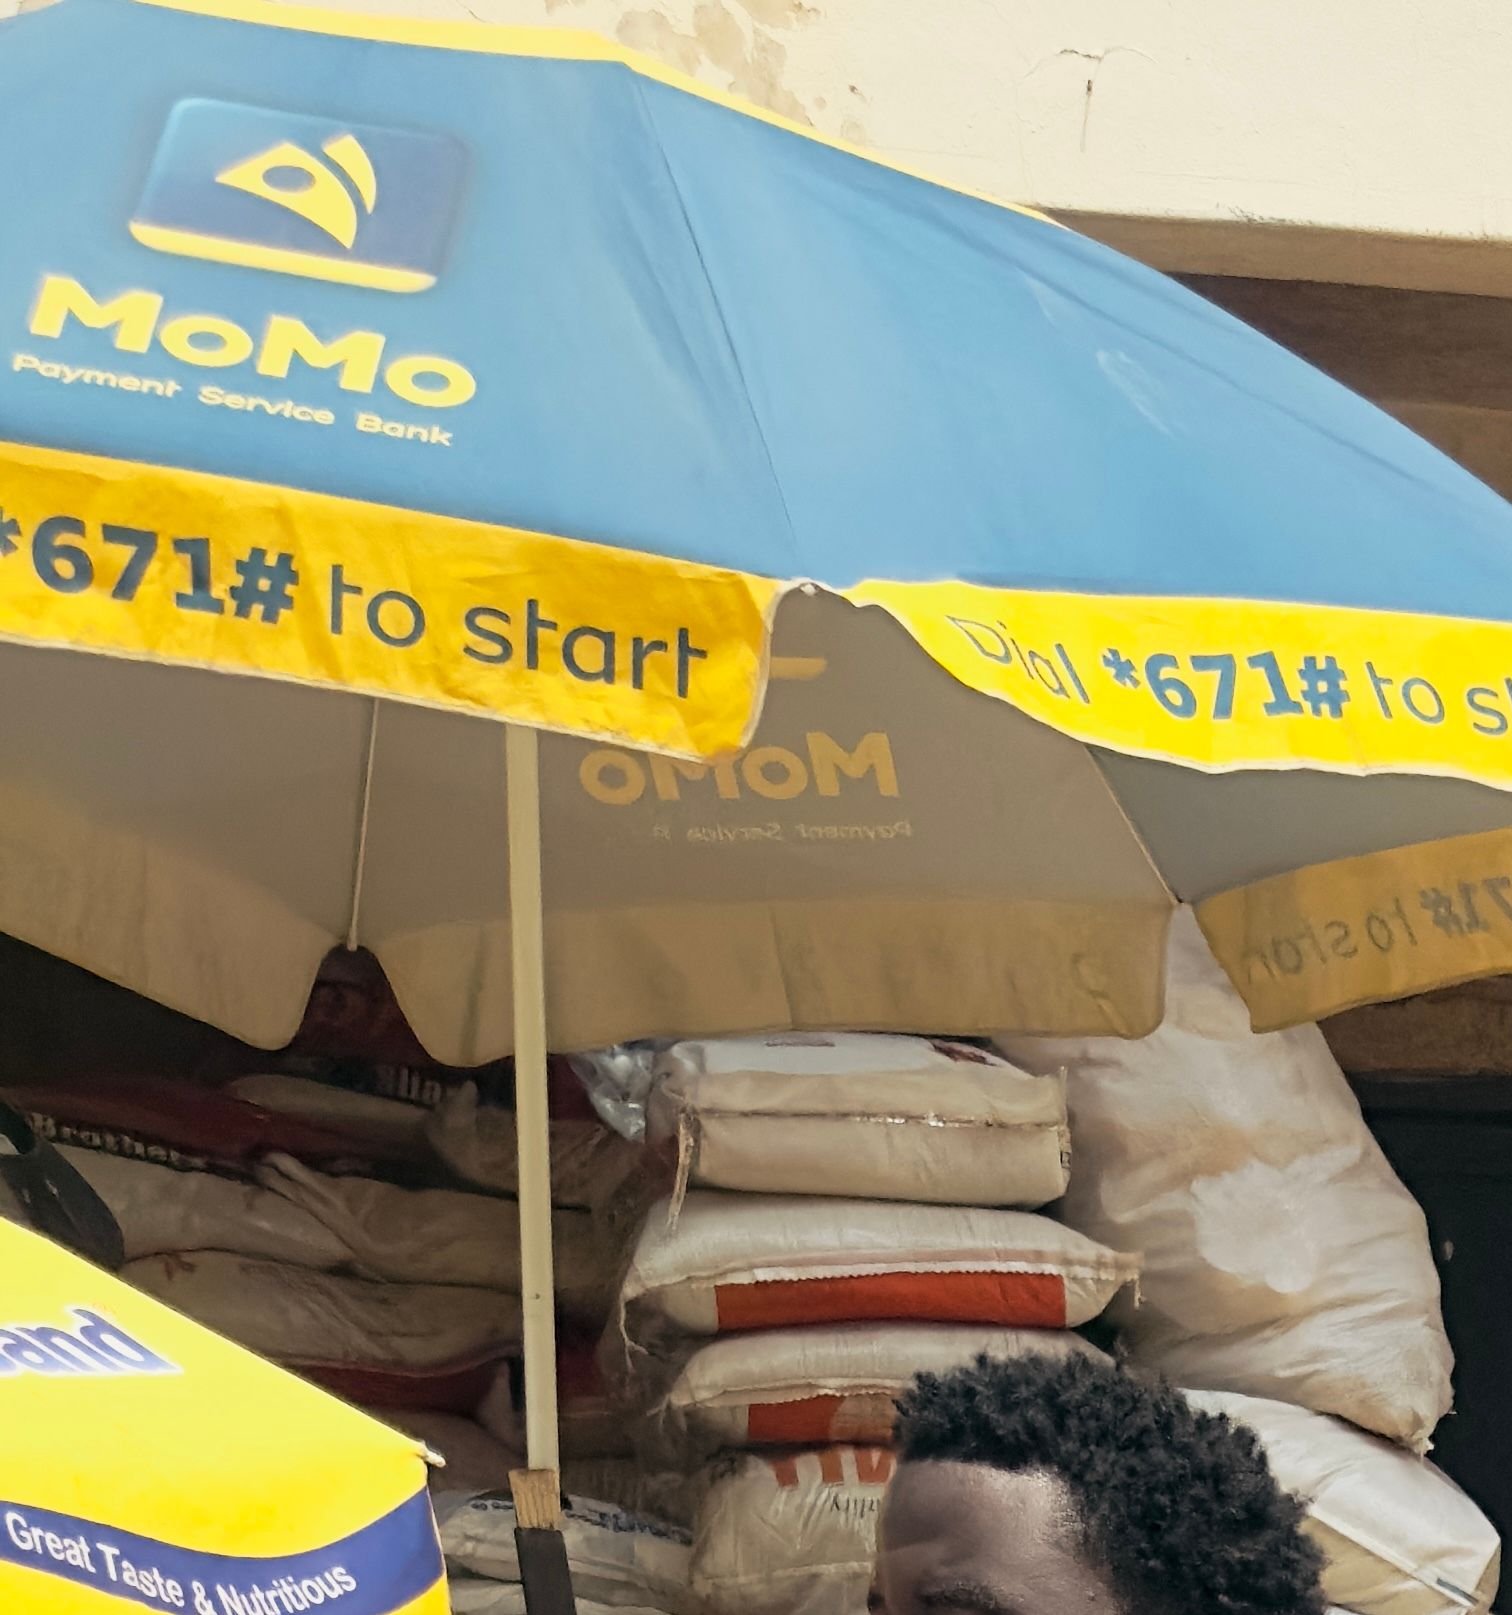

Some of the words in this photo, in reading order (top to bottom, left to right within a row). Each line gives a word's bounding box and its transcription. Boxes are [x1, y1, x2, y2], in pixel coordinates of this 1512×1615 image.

[29, 273, 477, 408] MoMo
[13, 353, 182, 399] Payment
[198, 384, 335, 426] Service
[356, 413, 453, 447] Bank
[330, 563, 426, 648] to
[463, 598, 707, 698] start
[946, 614, 1090, 705] Dial
[1366, 659, 1445, 725] to
[6, 1511, 96, 1574] Great
[97, 1543, 184, 1607] Taste
